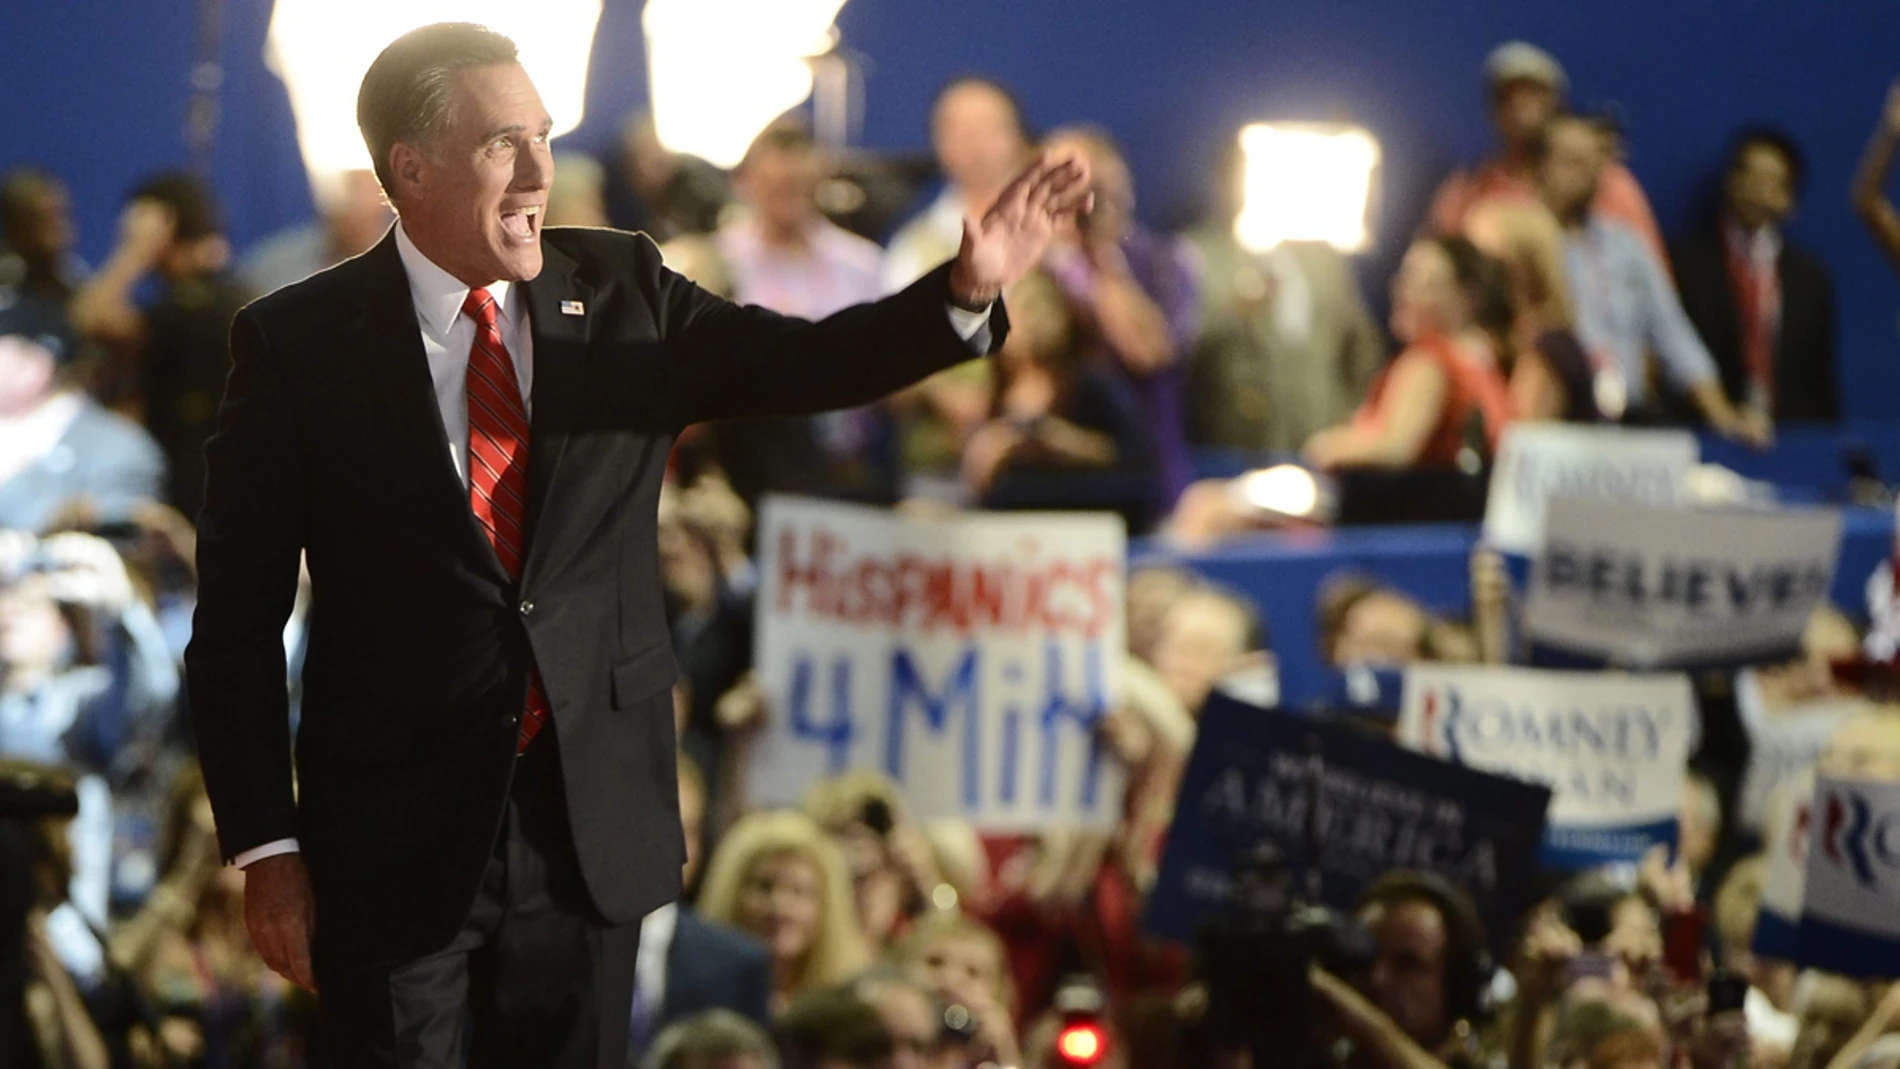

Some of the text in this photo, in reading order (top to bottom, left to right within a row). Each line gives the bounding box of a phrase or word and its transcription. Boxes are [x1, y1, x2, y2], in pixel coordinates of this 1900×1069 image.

[788, 655, 854, 774] 4
[1420, 683, 1674, 764] ROMNEY
[1203, 766, 1499, 894] AMERICA
